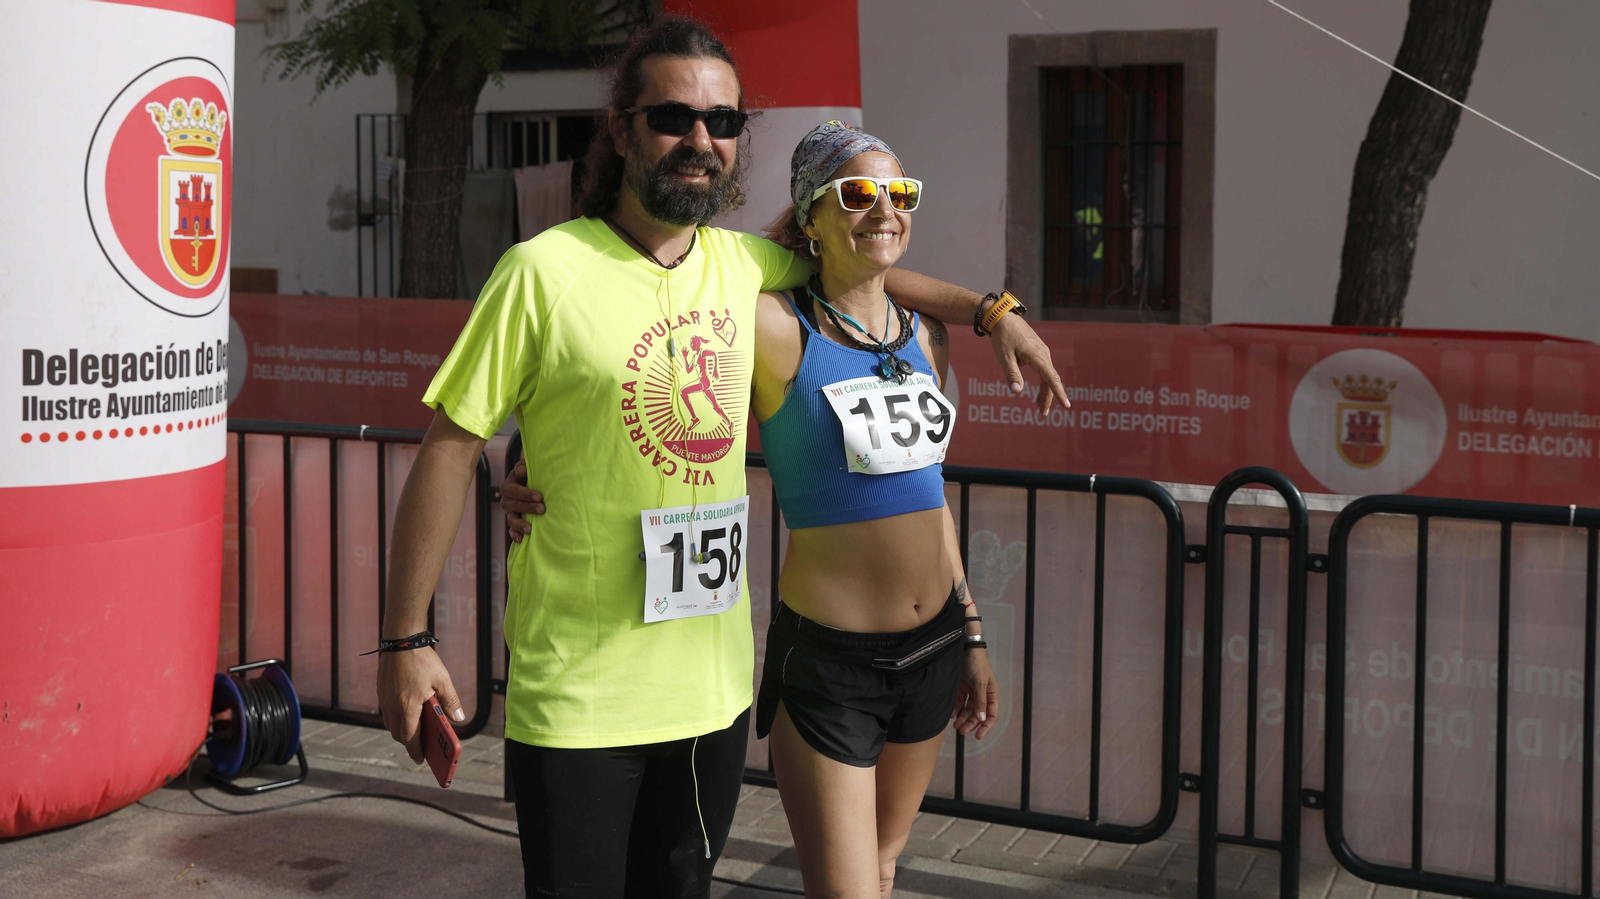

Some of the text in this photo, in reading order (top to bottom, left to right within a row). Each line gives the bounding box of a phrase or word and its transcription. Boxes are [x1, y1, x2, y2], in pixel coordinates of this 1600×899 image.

[626, 310, 701, 373] POPULAR
[22, 339, 229, 389] Delegación de De
[253, 342, 441, 369] Ilustre Ayuntamiento de San Roque
[253, 361, 408, 388] DELEGACIÓN DE DEPORTES
[831, 389, 843, 397] VII
[844, 381, 878, 394] CARRERA
[1020, 380, 1130, 405] Ayamiento
[1134, 385, 1154, 405] de
[1158, 386, 1190, 407] San
[1195, 388, 1250, 414] Roque
[22, 395, 101, 422] Ilustre
[106, 386, 213, 420] Ayuntamiento
[1458, 403, 1519, 425] Ilustre
[621, 380, 678, 476] CARRERA
[849, 391, 951, 450] 159
[1080, 409, 1103, 431] DE
[1107, 411, 1202, 435] DEPORTES
[701, 443, 731, 462] MAYORGA
[1458, 430, 1593, 458] DELEGACIÓN
[682, 467, 716, 486] VII
[649, 515, 661, 526] VII
[663, 511, 701, 525] CARRERA
[703, 505, 734, 521] SOLIDARIA
[660, 522, 742, 593] 158
